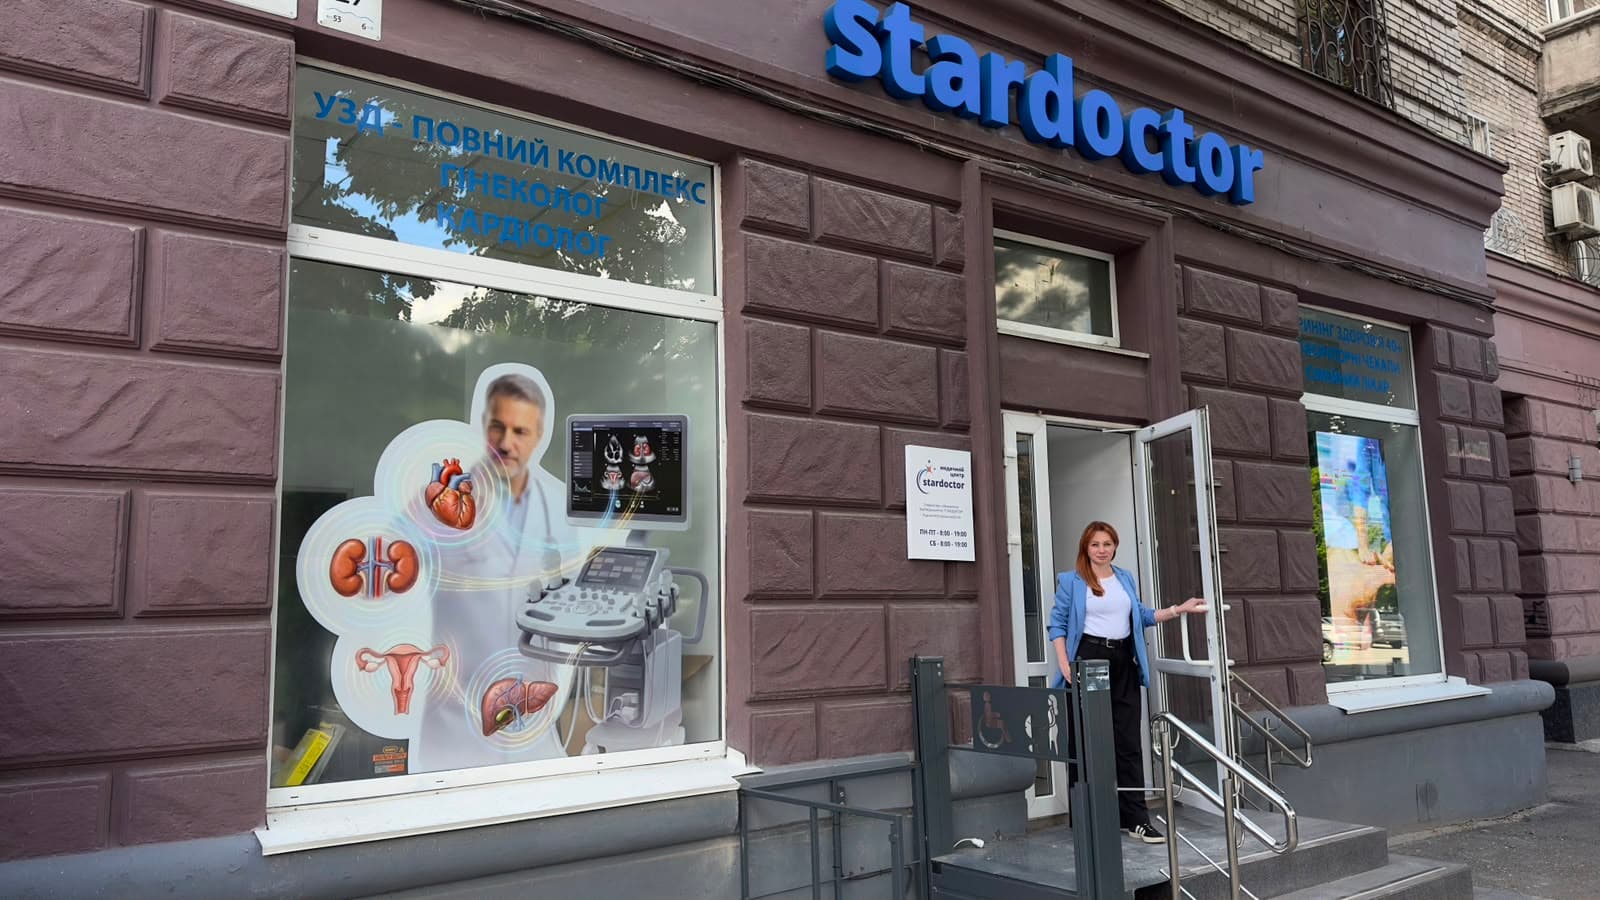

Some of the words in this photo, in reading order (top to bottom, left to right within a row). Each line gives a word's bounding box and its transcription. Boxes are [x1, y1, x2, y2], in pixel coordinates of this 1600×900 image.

[824, 0, 1265, 204] stardoctor
[314, 91, 384, 137] УЗД
[412, 115, 549, 169] ПОВНИЙ
[558, 149, 706, 205] КОМПЛЕКС
[440, 163, 608, 220] ГІНЕКОЛОГ
[437, 203, 612, 260] КАРДІОЛОГ
[923, 479, 965, 489] stardoctor
